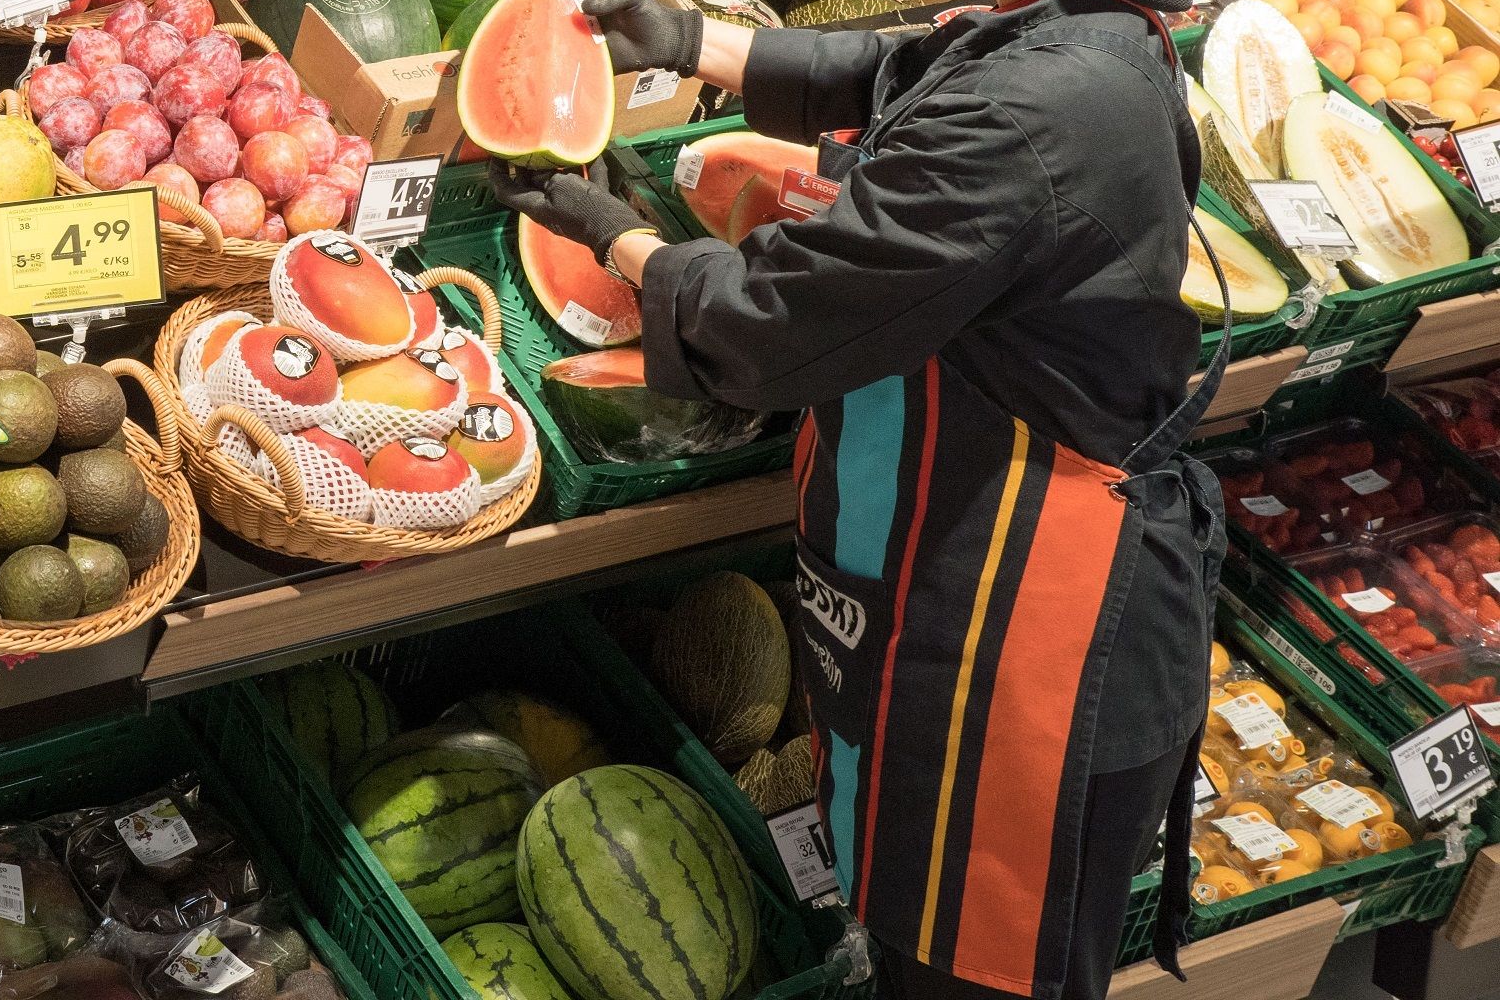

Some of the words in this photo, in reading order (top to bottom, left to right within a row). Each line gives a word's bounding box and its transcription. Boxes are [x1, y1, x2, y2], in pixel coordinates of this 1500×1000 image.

[1484, 157, 1499, 167] 201
[811, 181, 840, 196] EROSK
[389, 177, 436, 216] 4,75
[8, 206, 39, 215] AGUACATE
[39, 204, 65, 212] MADURO
[416, 200, 424, 212] €
[19, 222, 30, 231] 38
[51, 219, 130, 266] 4,99
[103, 255, 130, 266] €/Kg
[100, 269, 130, 279] 26-May
[1318, 677, 1333, 694] 106
[1425, 728, 1475, 792] 3,19
[1468, 751, 1478, 764] €
[800, 841, 815, 858] 32
